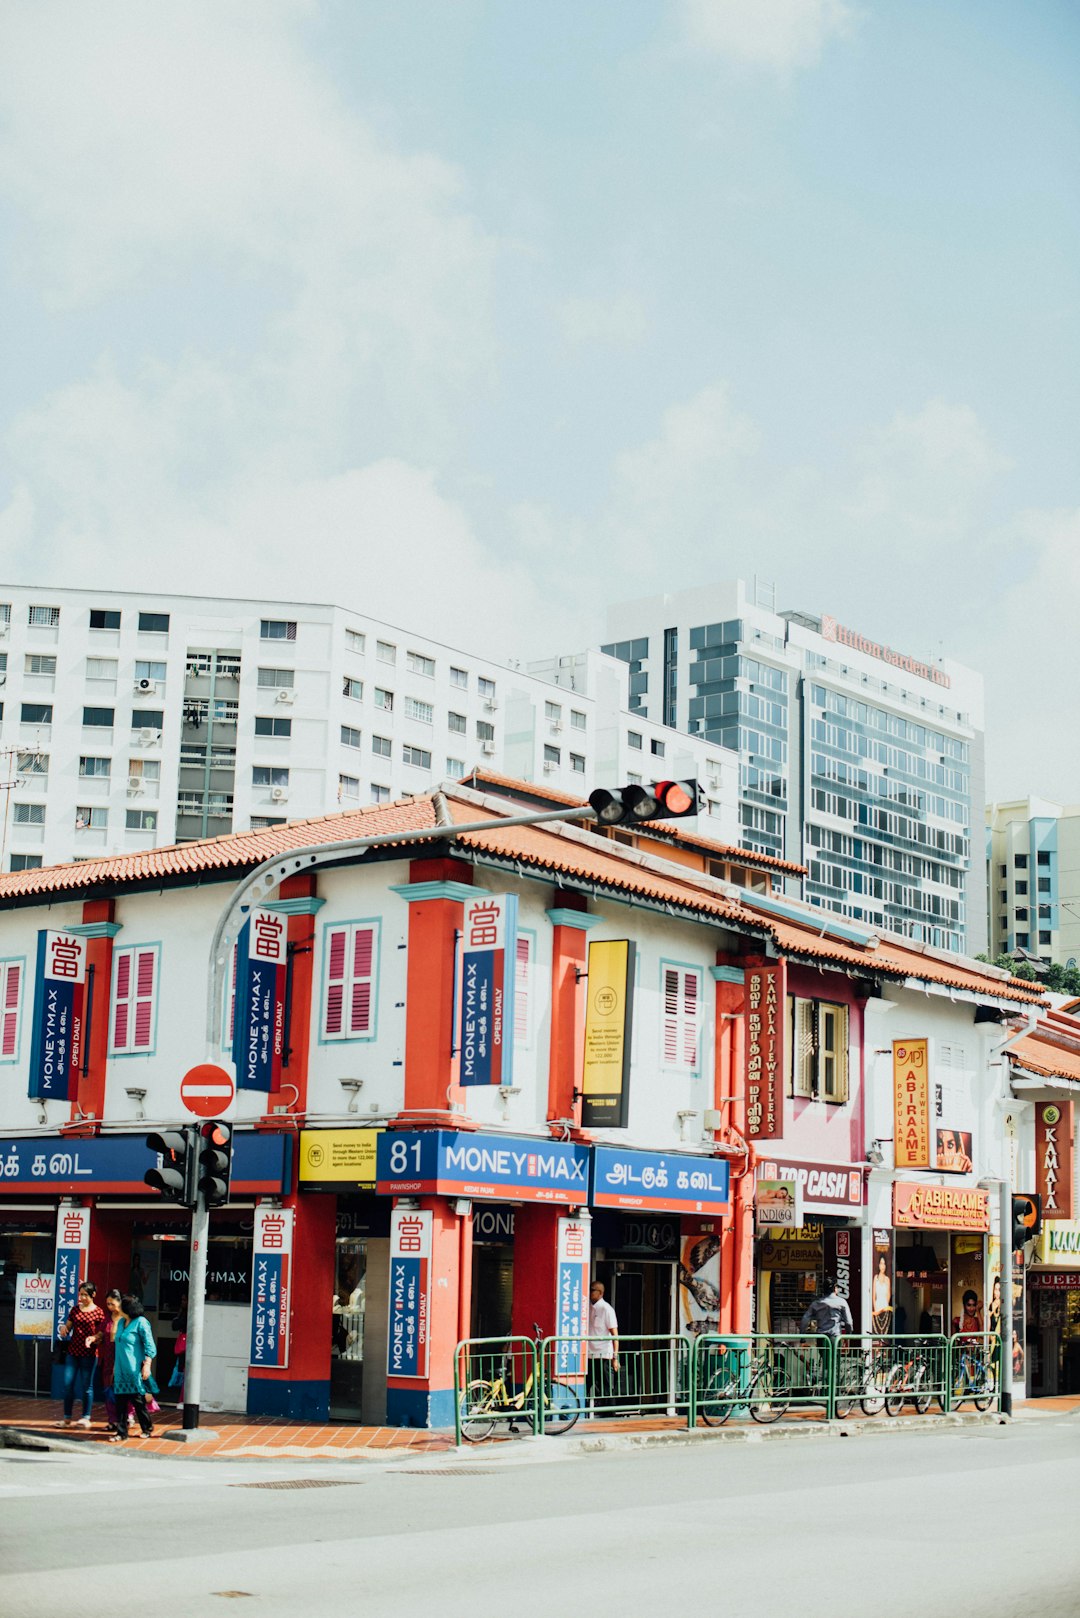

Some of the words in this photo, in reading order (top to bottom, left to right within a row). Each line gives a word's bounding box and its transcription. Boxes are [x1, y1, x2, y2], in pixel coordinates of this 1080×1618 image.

[837, 623, 881, 660] Hilton
[883, 645, 929, 679] Garden
[930, 663, 951, 689] Inn
[275, 1000, 283, 1027] DAILY
[494, 987, 503, 1015] DAILY
[766, 973, 777, 1035] KAMALA
[73, 1016, 81, 1039] DAILY
[248, 971, 262, 1079] MONEYMAX
[464, 963, 477, 1077] MONEYMAX
[493, 1016, 502, 1045] OPEN
[43, 989, 58, 1089] MONEYMAX
[71, 1040, 79, 1067] OPEN
[274, 1028, 282, 1055] OPEN
[765, 1039, 777, 1133] JEWELLERS
[905, 1070, 919, 1161] ABIRAAME
[31, 1153, 92, 1177] கடை
[390, 1140, 421, 1174] 81
[1043, 1128, 1059, 1209] KAMALA
[463, 1185, 479, 1194] KEDAI
[605, 1160, 668, 1189] அடகுக்
[676, 1170, 722, 1191] கடை
[925, 1189, 985, 1211] ABIRAAME
[25, 1278, 52, 1289] LOW
[837, 1257, 850, 1300] CASH
